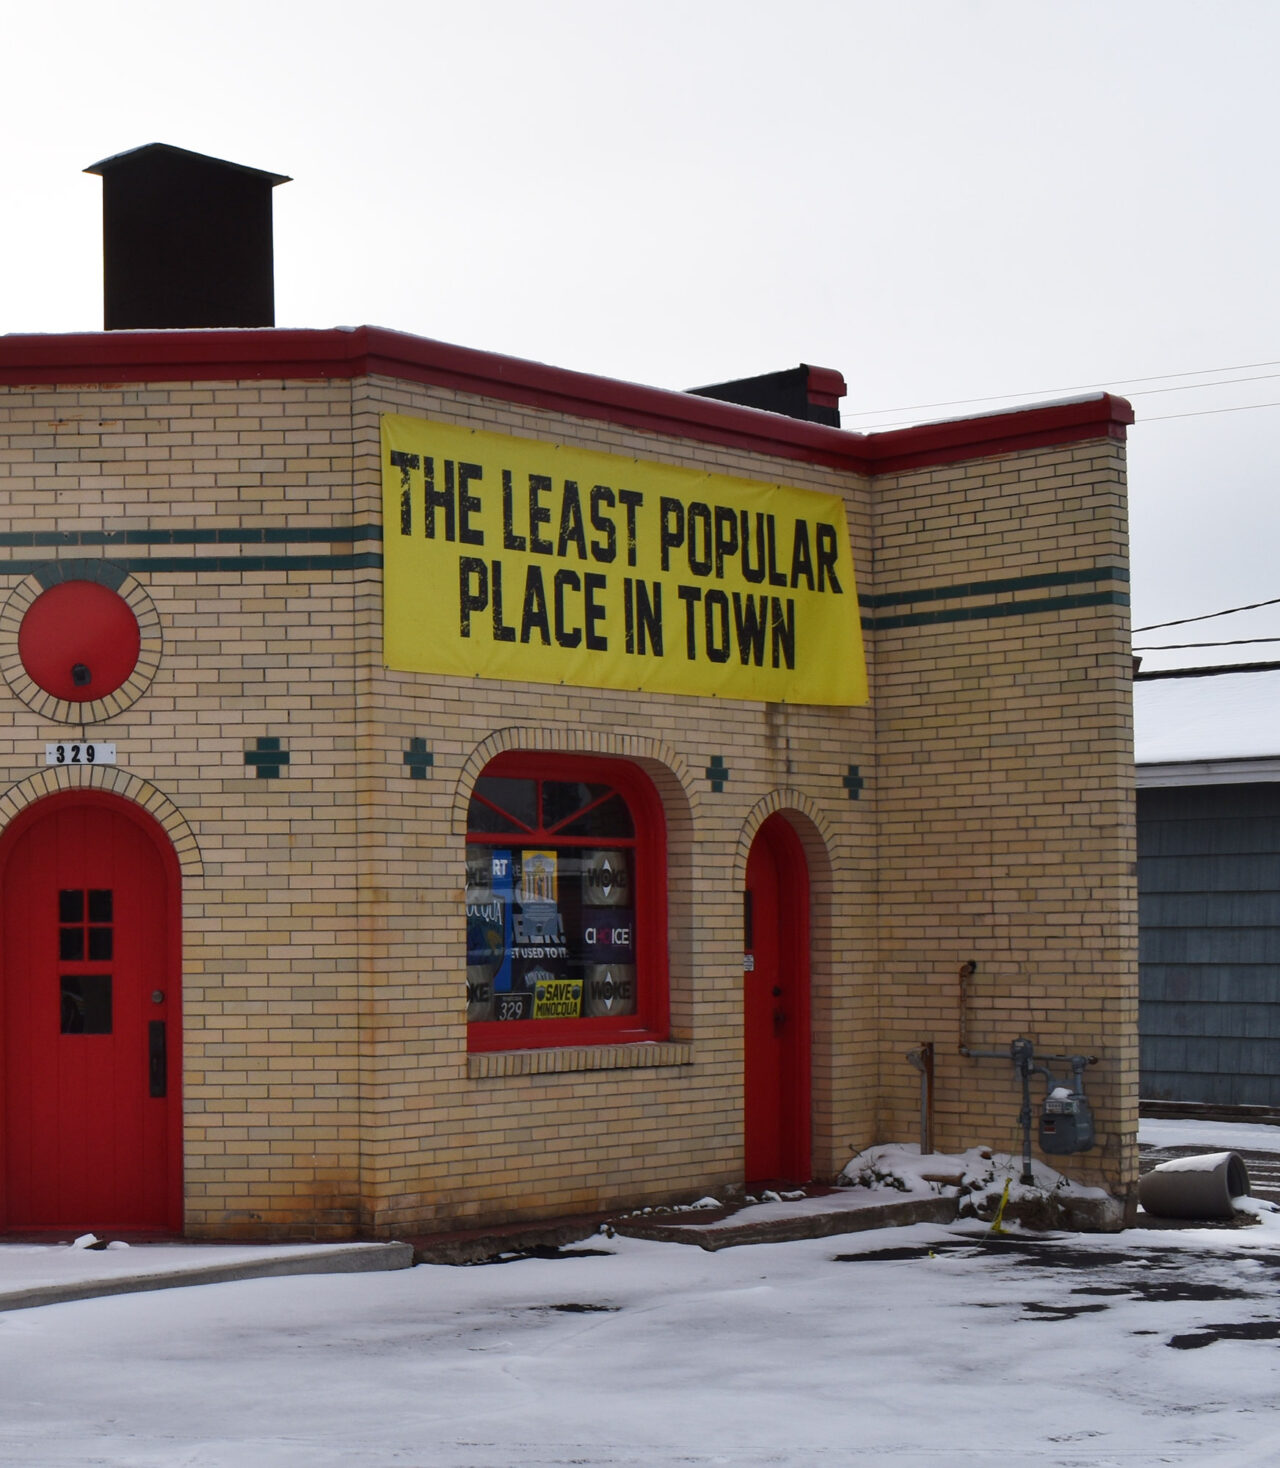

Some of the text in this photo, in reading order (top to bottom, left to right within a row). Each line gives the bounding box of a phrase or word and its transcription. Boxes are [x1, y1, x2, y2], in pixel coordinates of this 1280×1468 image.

[390, 450, 843, 594] THE LEAST POPULAR
[459, 556, 796, 670] PLACE IN TOWN
[56, 744, 96, 763] 329
[587, 867, 627, 888] WOKE
[521, 947, 544, 958] USED
[544, 947, 557, 958] TO
[545, 983, 572, 1001] SAVE
[591, 981, 632, 1000] WOKE
[499, 1001, 523, 1020] 329
[536, 1002, 578, 1016] MINOCQUA
